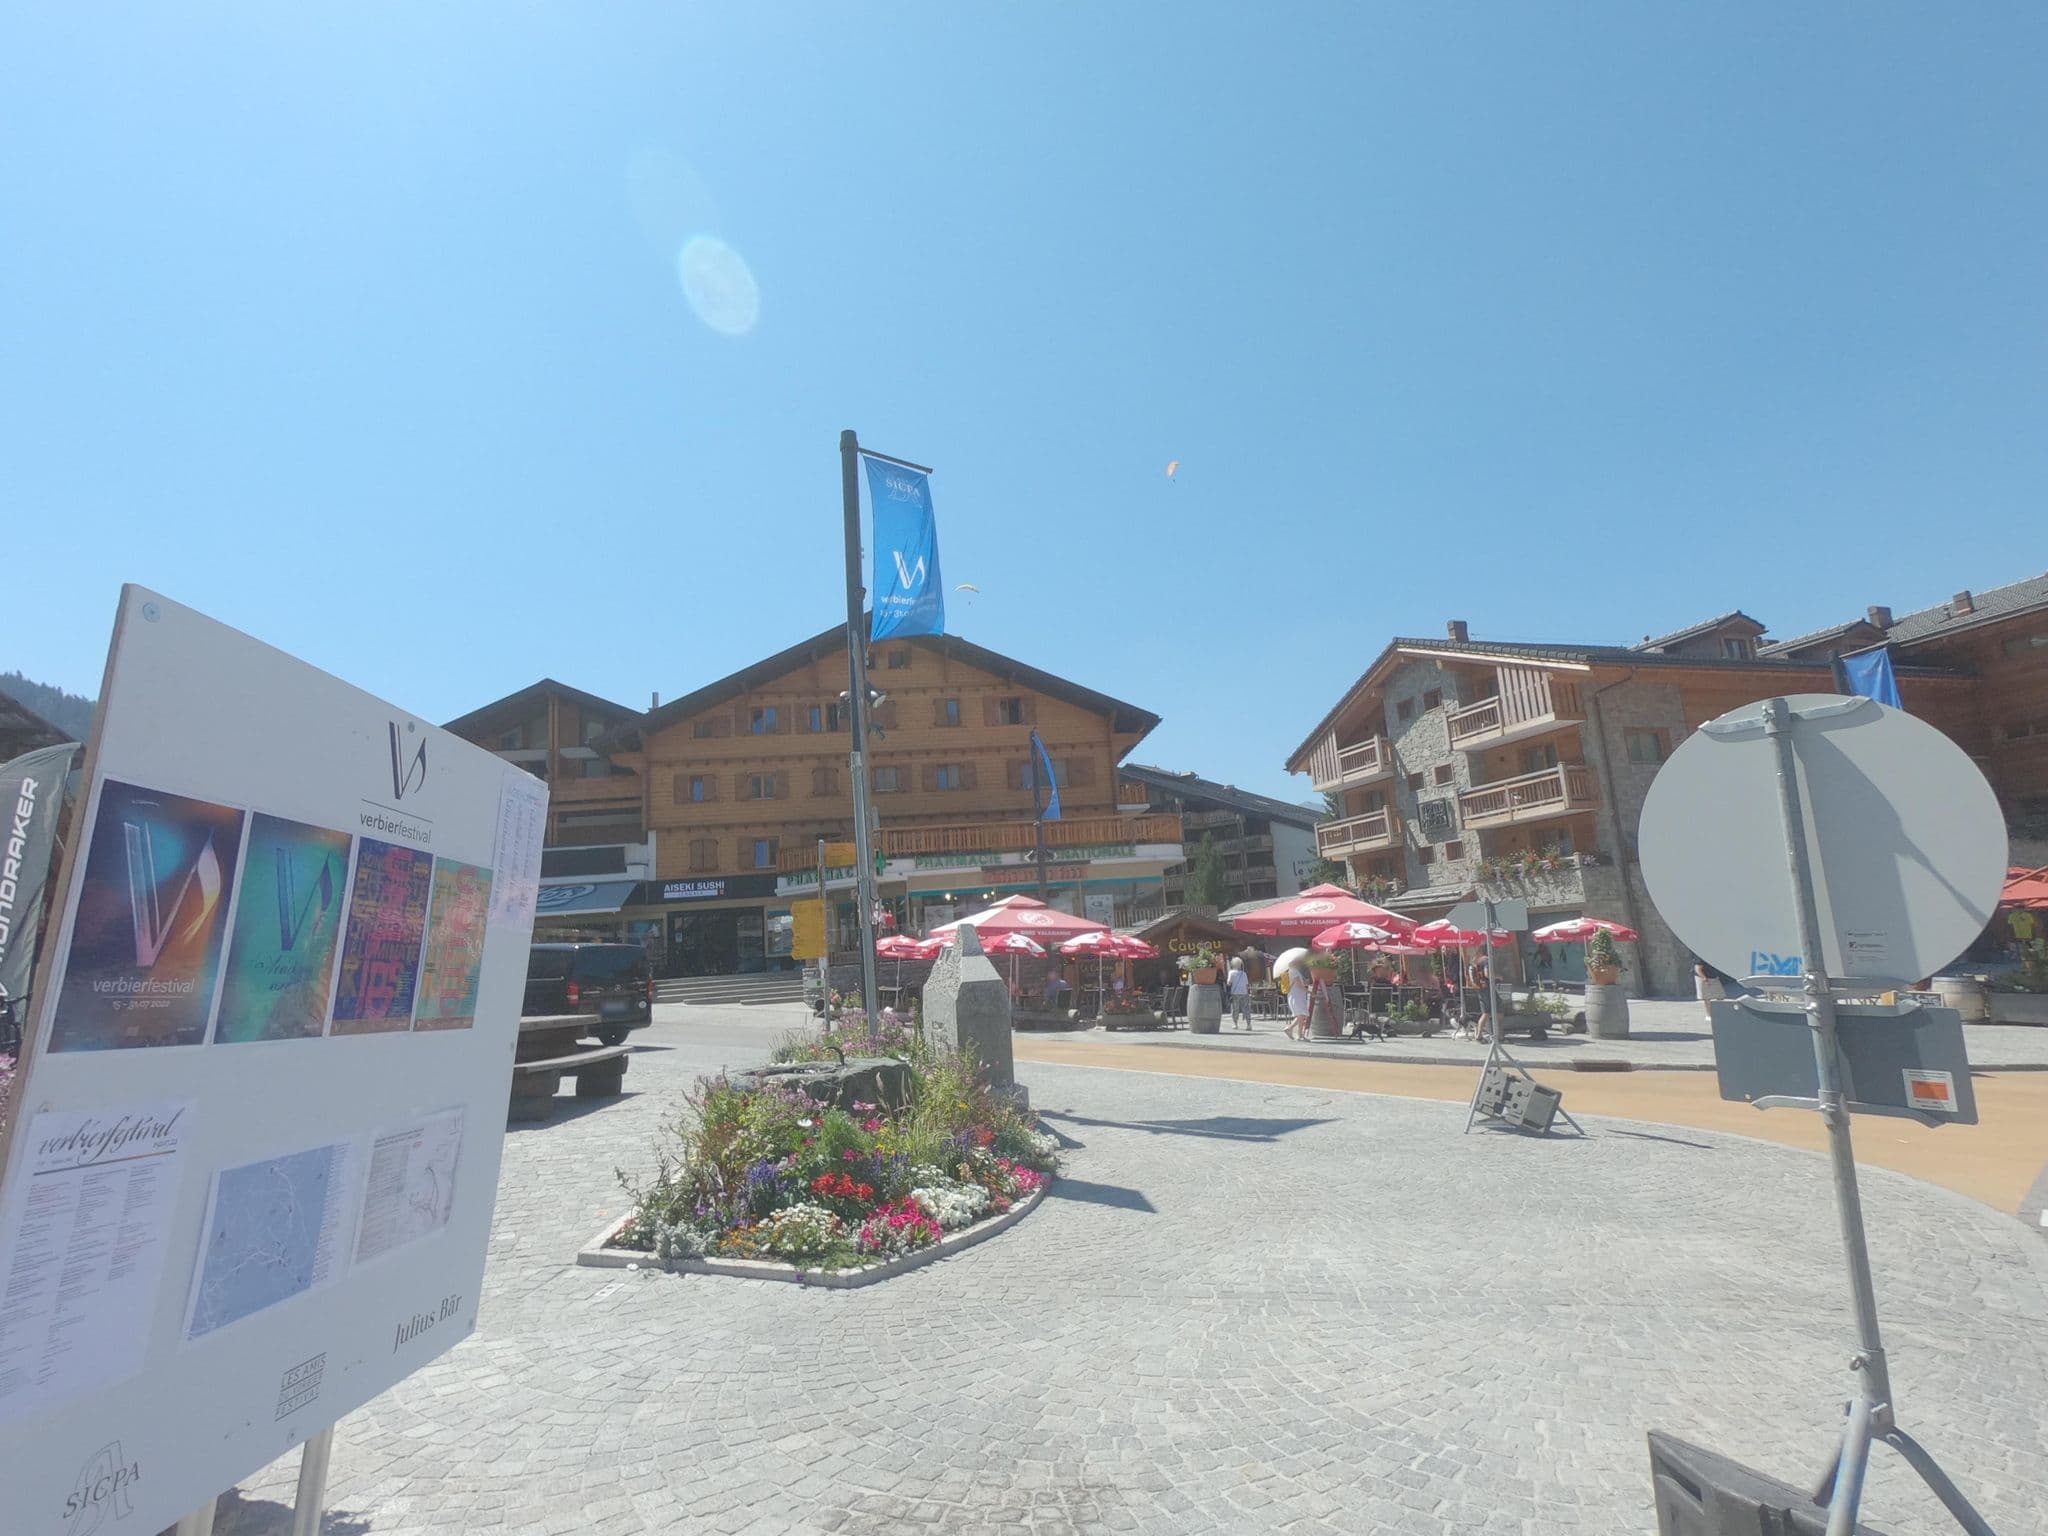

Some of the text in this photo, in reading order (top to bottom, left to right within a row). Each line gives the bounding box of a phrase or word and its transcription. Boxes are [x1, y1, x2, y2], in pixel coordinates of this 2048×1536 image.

[886, 478, 921, 497] SICPA
[360, 813, 432, 844] verbierfestival
[0, 777, 39, 962] ONDRAKER
[916, 853, 1001, 869] PHARMACIE
[664, 880, 725, 892] AISEKI SUSHI
[93, 976, 195, 994] verbierfestival
[393, 1294, 463, 1355] Julius Bär
[280, 1356, 327, 1389] LES AMIS
[63, 1461, 140, 1519] SICPA
